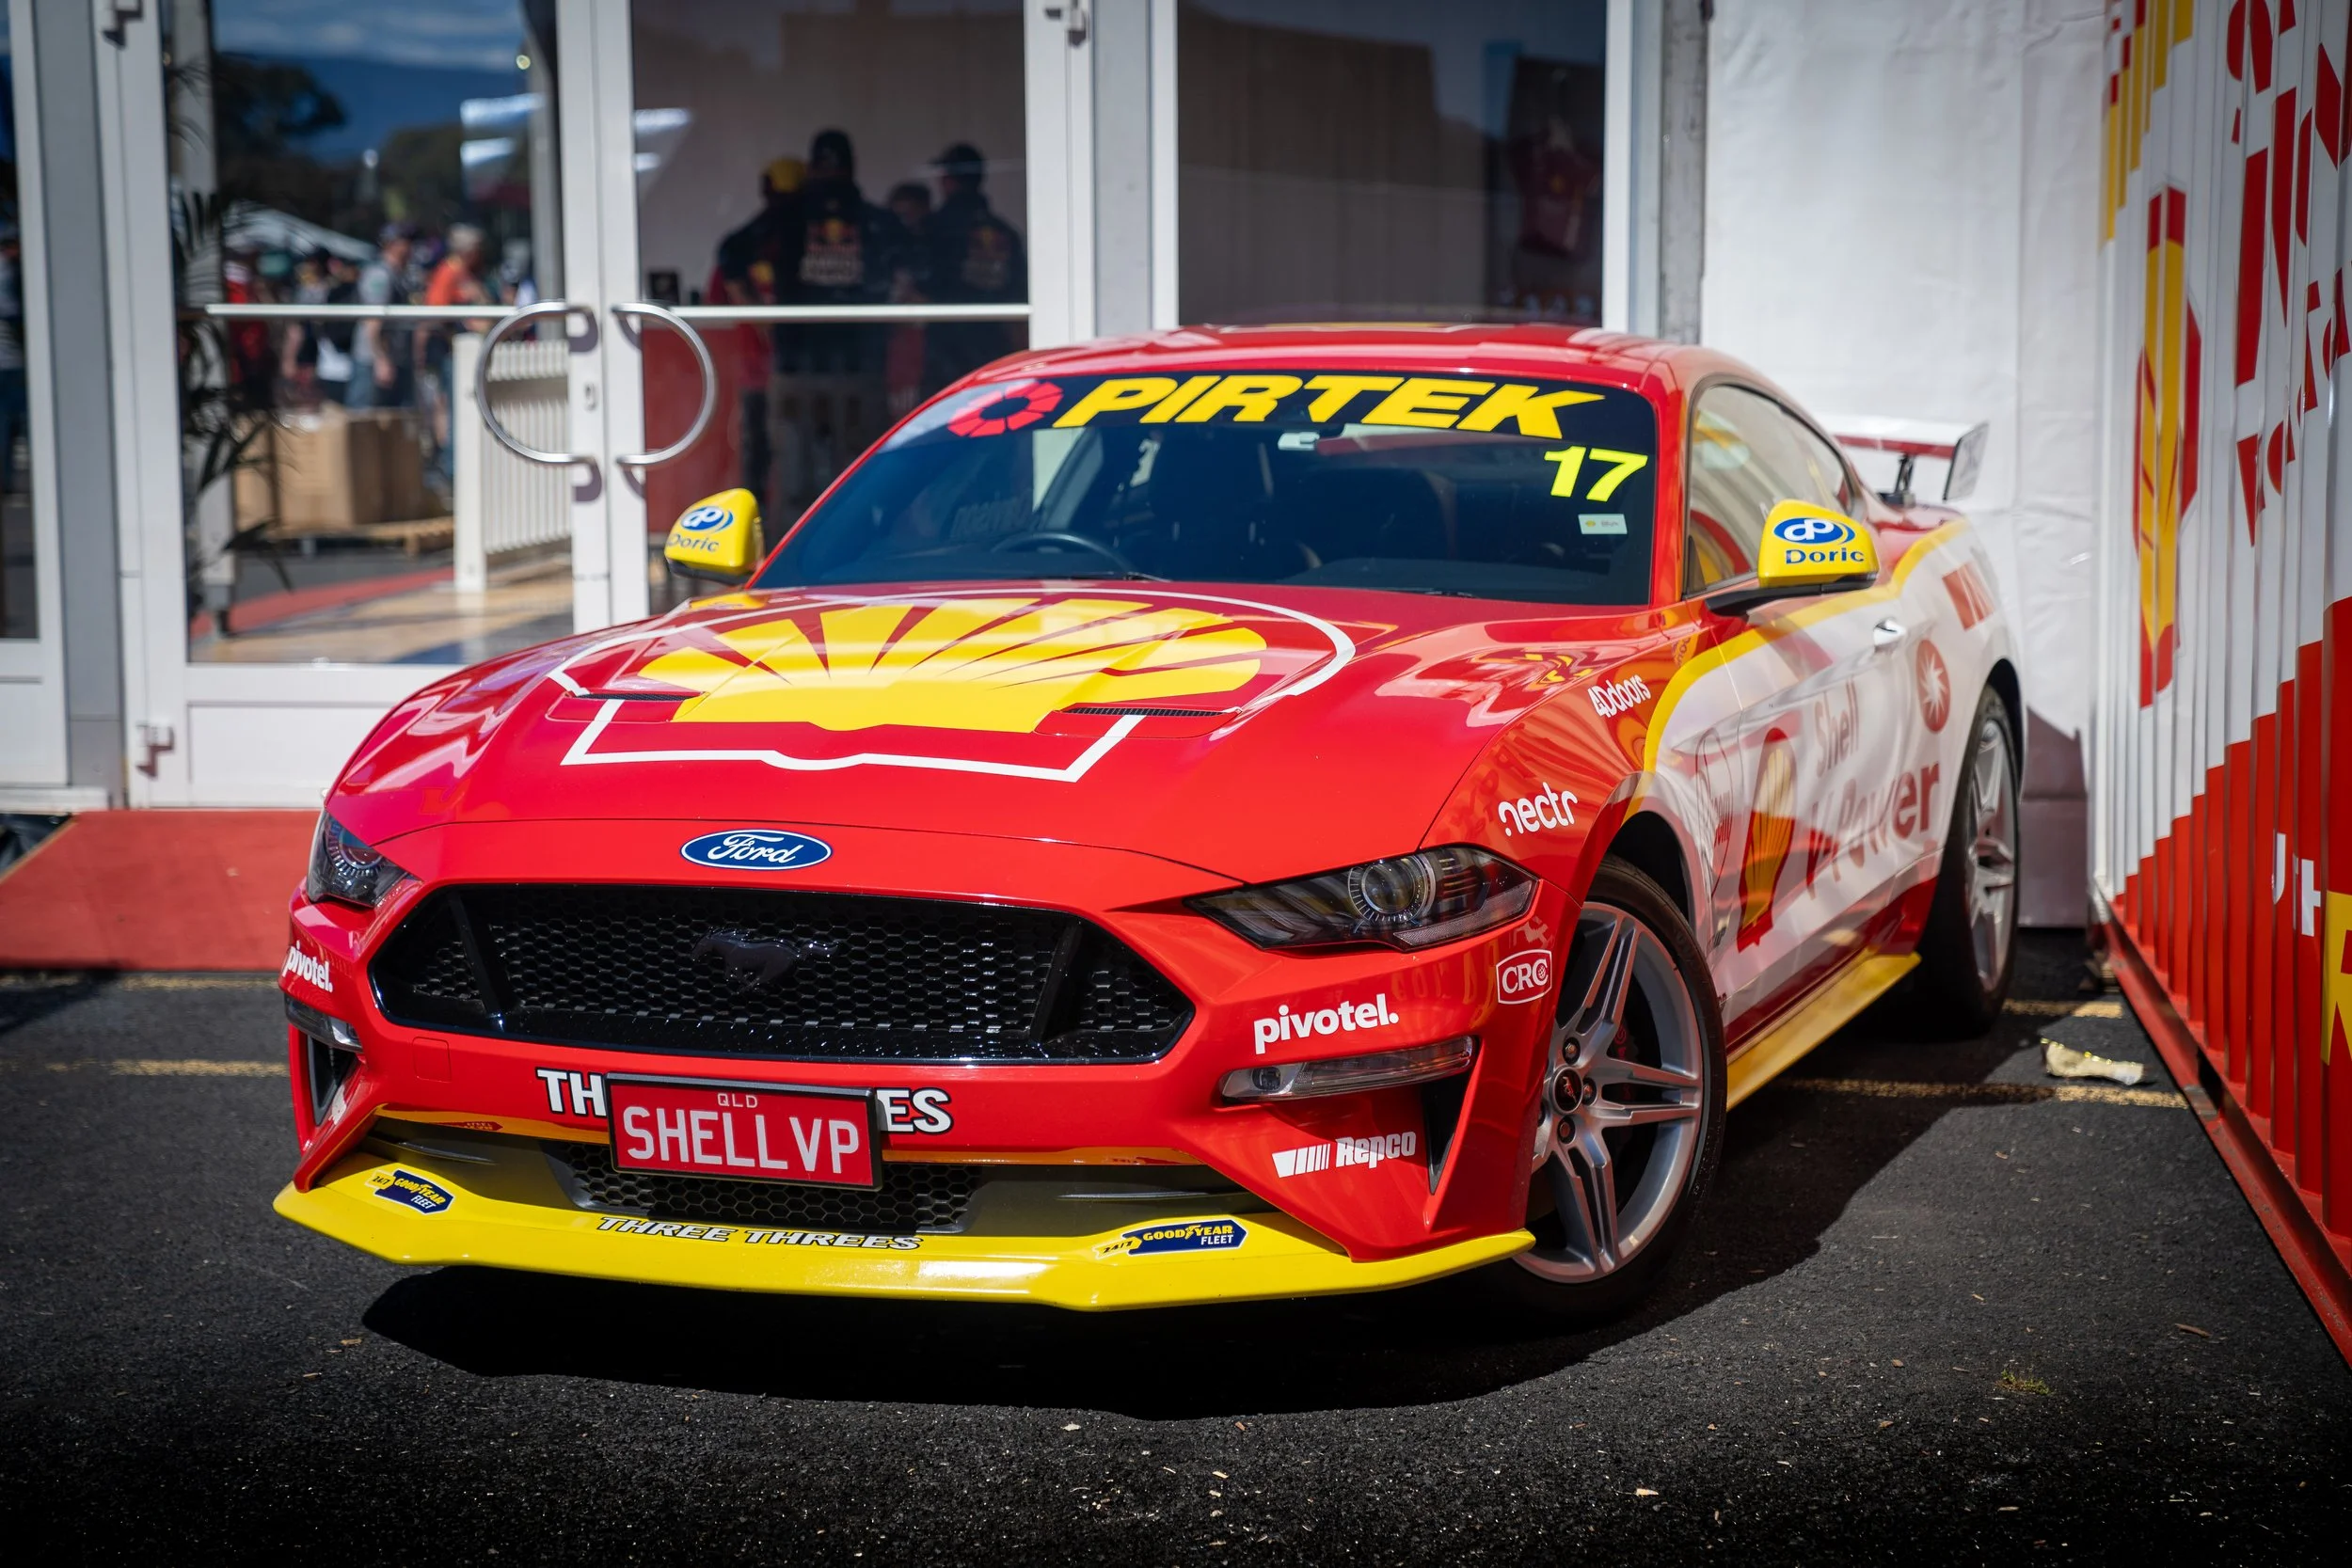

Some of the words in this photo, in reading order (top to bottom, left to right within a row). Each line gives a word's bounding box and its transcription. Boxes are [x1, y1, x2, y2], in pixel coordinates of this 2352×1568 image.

[1053, 374, 1606, 440] PIRTEK
[1544, 445, 1648, 502] 17
[667, 533, 720, 552] Doric
[1786, 547, 1865, 564] Doric
[1814, 674, 1860, 779] Shell
[707, 833, 804, 863] Ford
[282, 940, 333, 993] pivotel.
[1502, 958, 1549, 994] CRC
[1254, 993, 1400, 1054] pivotel.
[717, 1093, 758, 1109] QLD
[1335, 1131, 1417, 1169] Repco
[411, 1195, 437, 1209] FLEET
[596, 1216, 738, 1243] THREE
[744, 1229, 924, 1250] THREES
[1103, 1241, 1134, 1254] 24/7
[1142, 1224, 1234, 1241] GOODYEAR
[1200, 1234, 1234, 1246] FLEET
